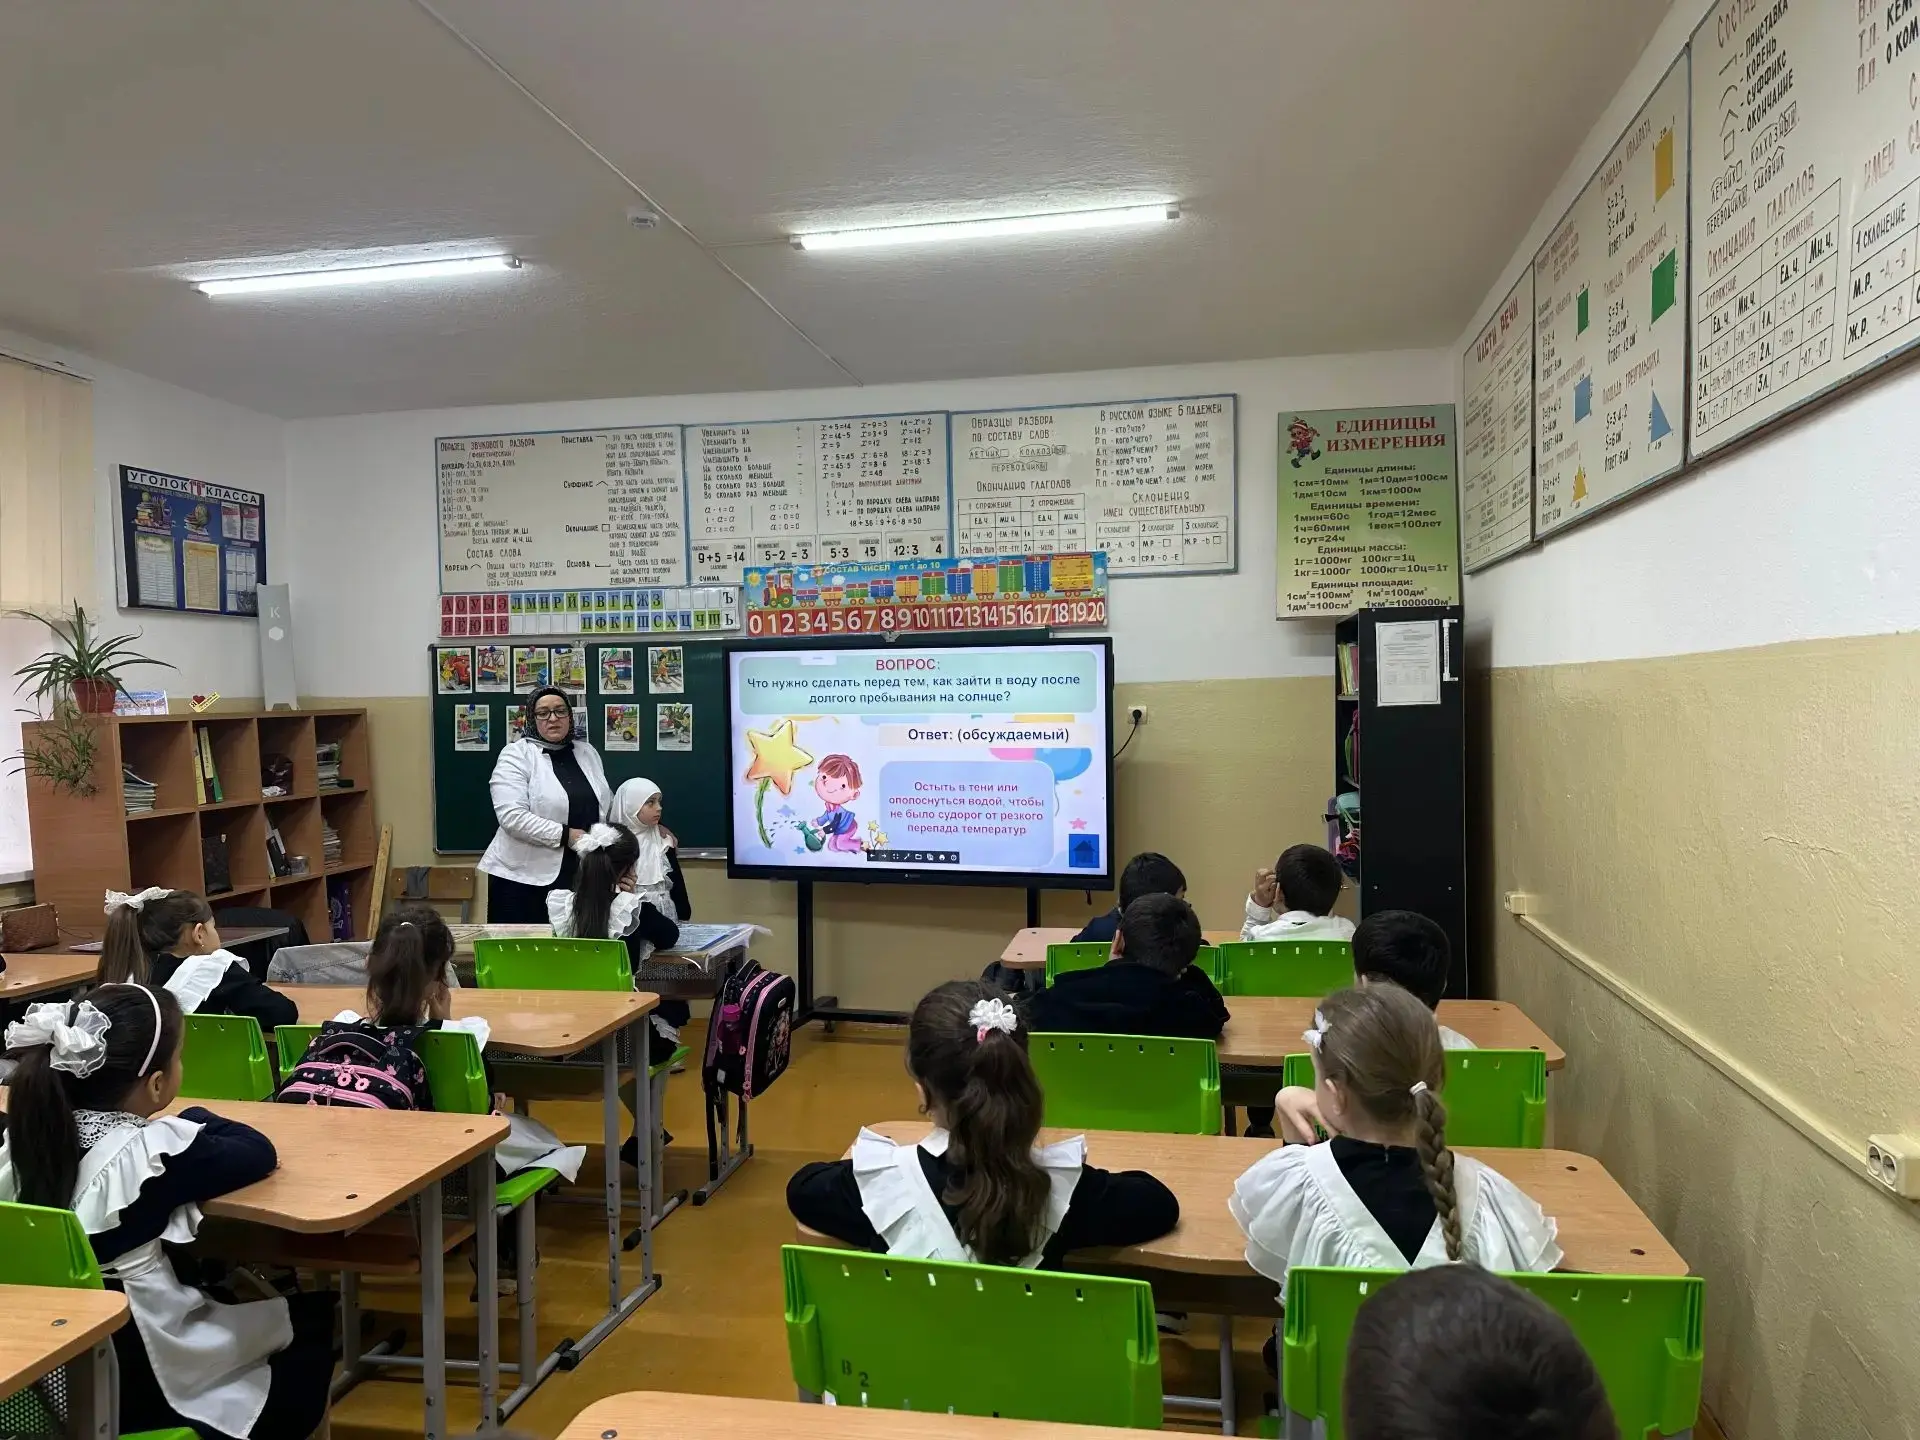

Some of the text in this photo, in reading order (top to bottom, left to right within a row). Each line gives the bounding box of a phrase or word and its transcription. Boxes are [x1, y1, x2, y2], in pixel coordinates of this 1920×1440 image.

[1746, 0, 1788, 58] ПРИСТАВКА
[1746, 36, 1776, 82] КОРЕНЬ
[1746, 49, 1787, 106] СУФФИКС
[1747, 68, 1793, 132] ОКОНЧАНИЕ
[1766, 163, 1815, 229] ГЛАГОЛОВ
[1862, 202, 1906, 249] СКЛОНЕНИЕ
[1100, 410, 1106, 421] В
[1109, 410, 1144, 420] РУССКОМ
[1148, 407, 1173, 418] ЯЗЫКЕ
[1177, 404, 1184, 416] 6
[971, 415, 1053, 429] ОБРАЗЦЫ РАЗБОРА
[1336, 416, 1437, 434] ЕДИНИЦЫ
[561, 435, 593, 444] ПРИСТАВКА
[972, 432, 982, 442] ПО
[987, 431, 1022, 442] СОСТАВУ
[1326, 433, 1446, 452] ИЗМЕРЕНИЯ
[1324, 464, 1416, 475] Единицы длины:
[563, 481, 594, 489] СУФФИКС
[976, 479, 1072, 493] ОКОНЧАНИЯ ГЛАГОЛОВ
[1293, 474, 1448, 487] 1см=10мм 1м=10дм=100см
[130, 471, 188, 491] УГОЛОК
[206, 486, 258, 504] КЛАССА
[1292, 486, 1422, 499] 1дм=10см 1км=1000м
[1132, 491, 1190, 504] СКЛОНЕНИЯ
[1129, 504, 1206, 517] СУЩЕСТВИТЕЛЬНЫХ
[1310, 499, 1420, 511] Единицы времени:
[1294, 509, 1437, 522] 1мин=60с 1год=12мес
[1294, 520, 1442, 533] 1ч=60мин 1век=100лет
[1293, 534, 1346, 545] 1сут=24ч
[466, 548, 522, 559] СОСТАВ СЛОВА
[1317, 543, 1407, 555] Единицы массы:
[566, 559, 591, 568] ОСНОВА
[1294, 553, 1416, 566] 1г=1000мг 100кг=1ц
[824, 566, 859, 574] СОСТАВ
[861, 563, 891, 572] ЧИСЕЛ
[1294, 563, 1449, 577] 1кг=1000г 1000кг=10ц=1т
[1311, 579, 1413, 590] Единицы площади:
[749, 601, 1105, 634] 0 1 2 3 4 5 6 7 8 9 10 11 12 13 14 15 16 17 18 19 20
[875, 658, 940, 671] ВОПРОС:
[747, 676, 1081, 690] Что нужно сделать перед тем, как зайти в воду после
[809, 691, 1011, 704] долгого пребывания на солнце?
[908, 728, 1070, 743] Ответ: (обсуждаемый)
[914, 781, 1018, 792] Остыть в тени или
[968, 797, 1006, 807] водой,
[1009, 797, 1044, 807] чтобы
[890, 809, 1043, 822] не было судорог от резкого
[907, 824, 1027, 837] перепада температур
